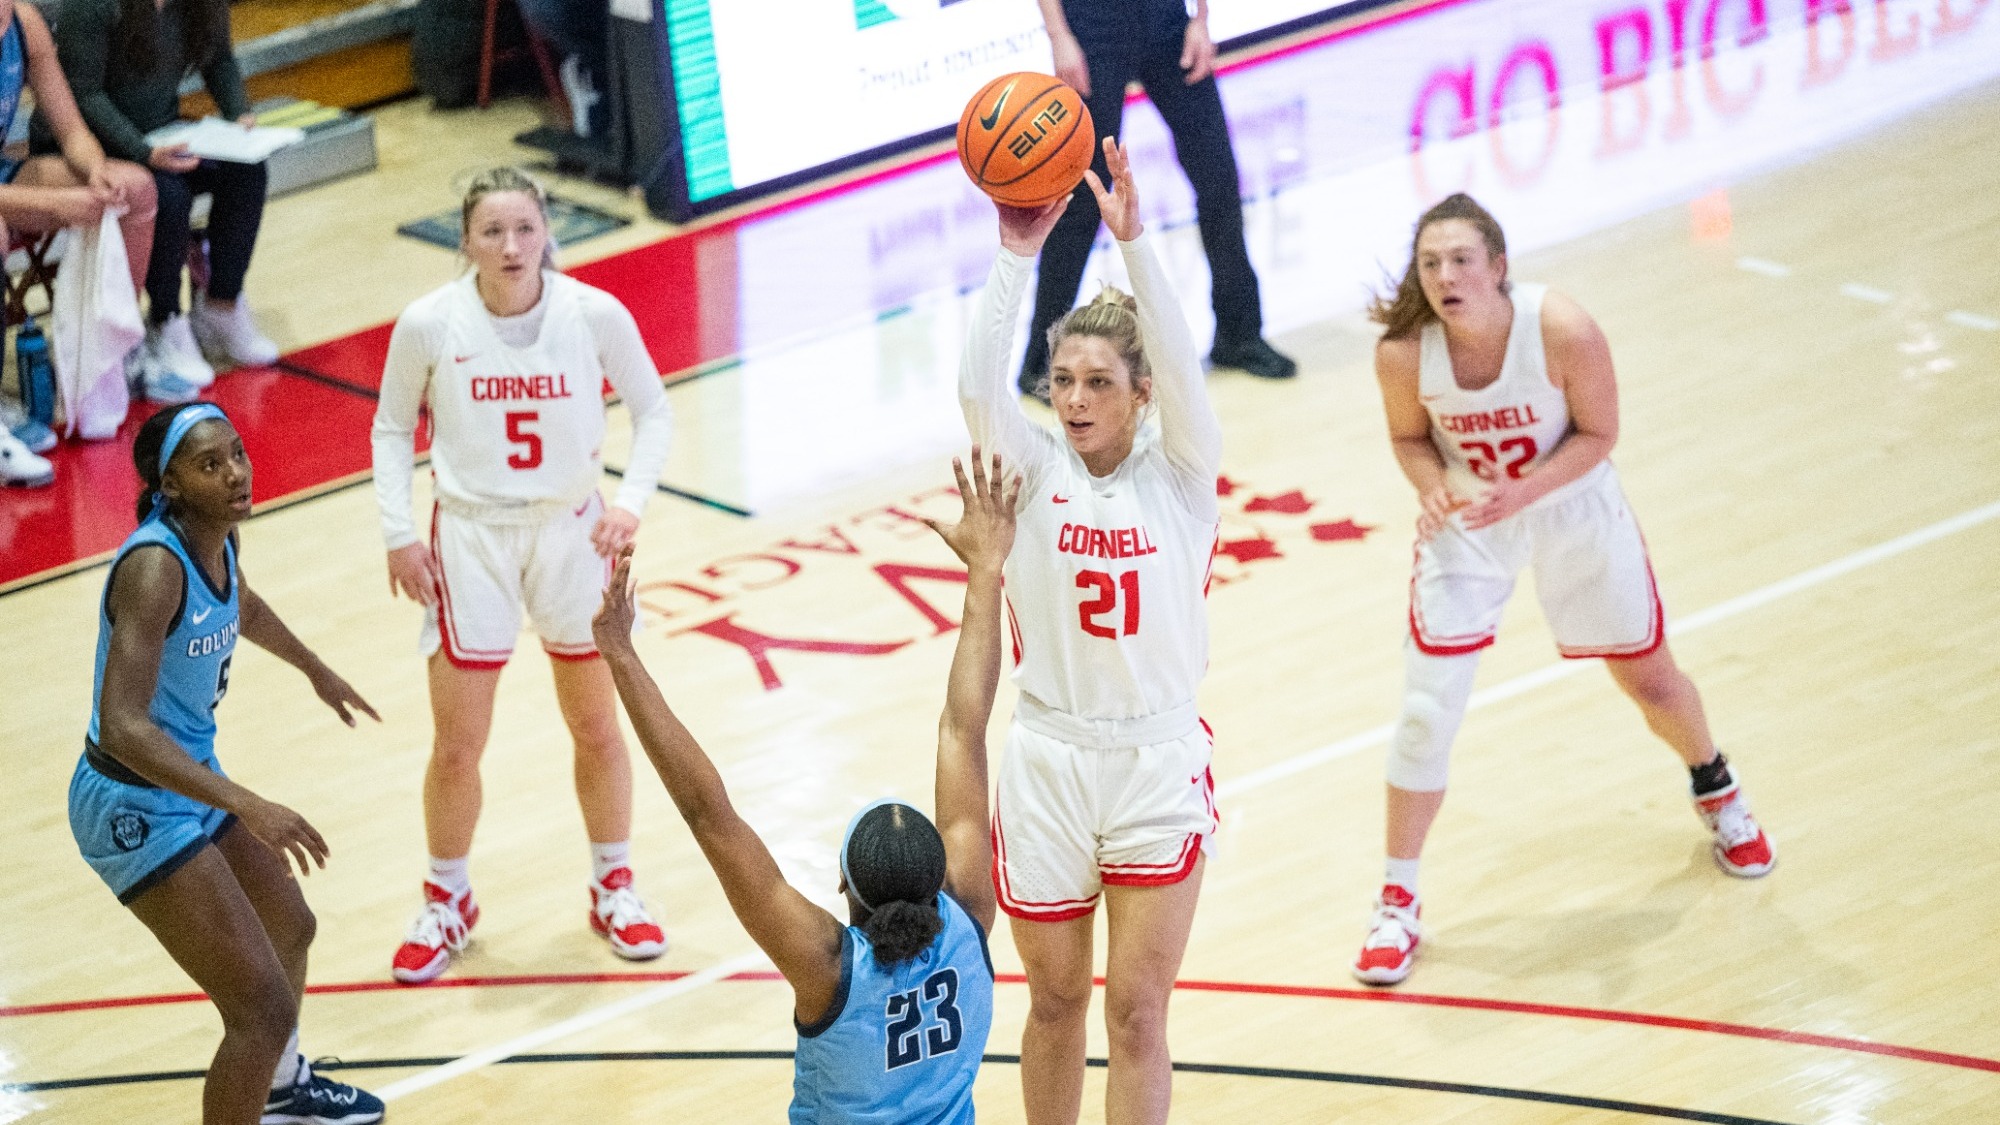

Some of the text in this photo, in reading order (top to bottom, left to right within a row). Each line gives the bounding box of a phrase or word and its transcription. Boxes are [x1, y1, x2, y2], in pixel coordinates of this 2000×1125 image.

[1007, 99, 1068, 160] ELITE
[471, 373, 572, 401] CORNELL
[506, 410, 543, 470] 5
[1439, 404, 1540, 434] CORNELL
[1058, 522, 1157, 559] CORNELL
[1076, 569, 1140, 640] 21
[187, 613, 240, 658] COLUM
[884, 966, 964, 1073] 23
